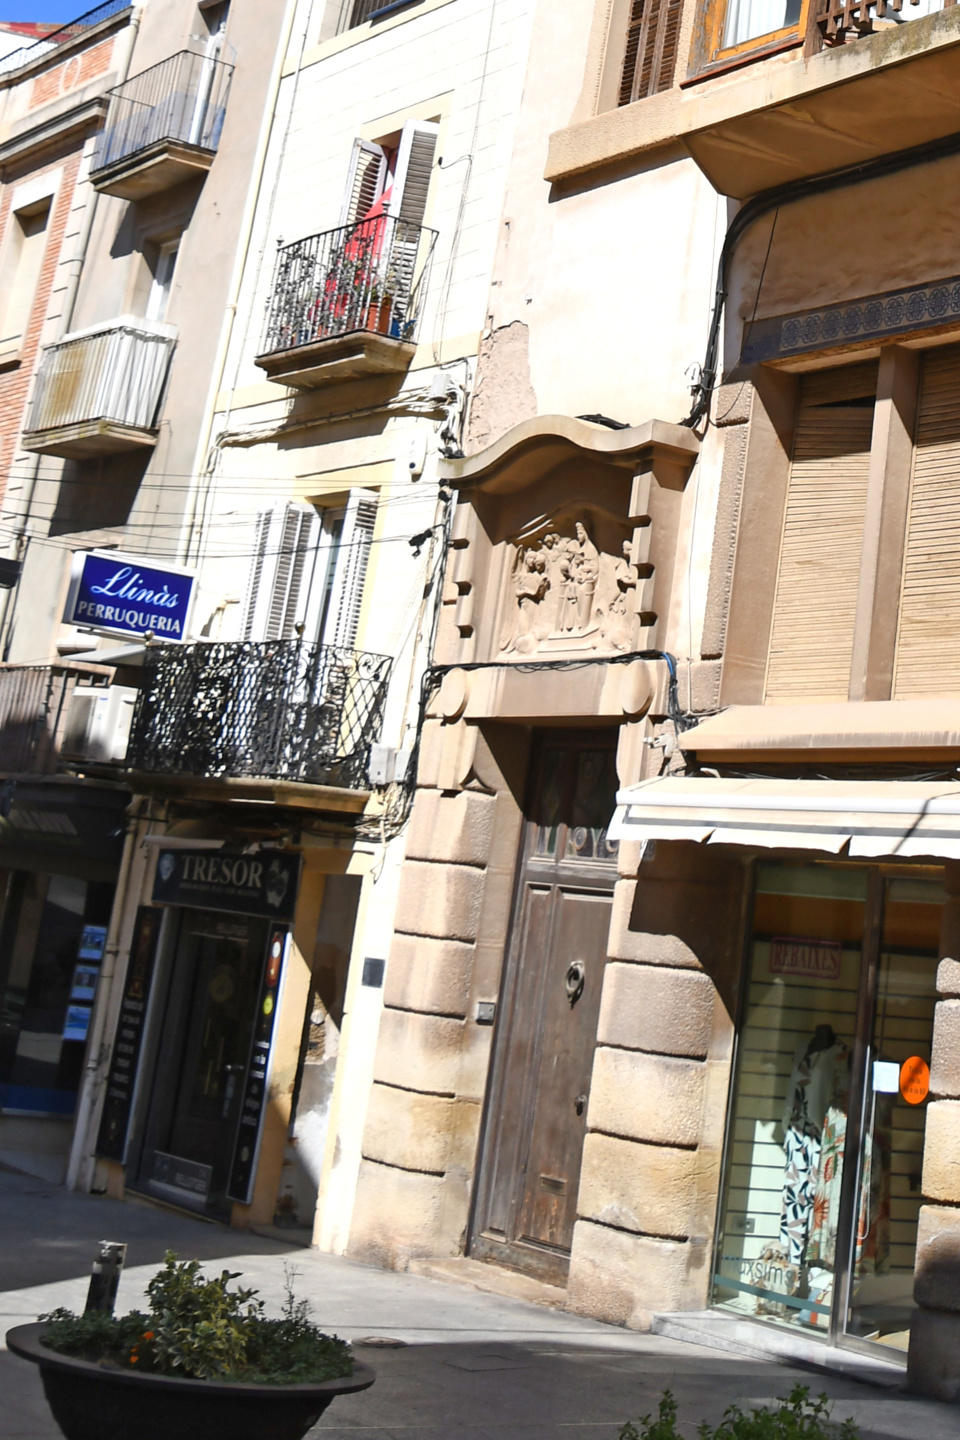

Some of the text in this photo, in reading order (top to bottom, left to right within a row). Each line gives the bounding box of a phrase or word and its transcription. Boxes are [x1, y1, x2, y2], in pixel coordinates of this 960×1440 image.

[90, 566, 179, 608] Llinàs
[77, 601, 181, 634] PERRUQUERIA
[181, 855, 264, 889] TRESOR
[774, 942, 838, 972] REBAIXES
